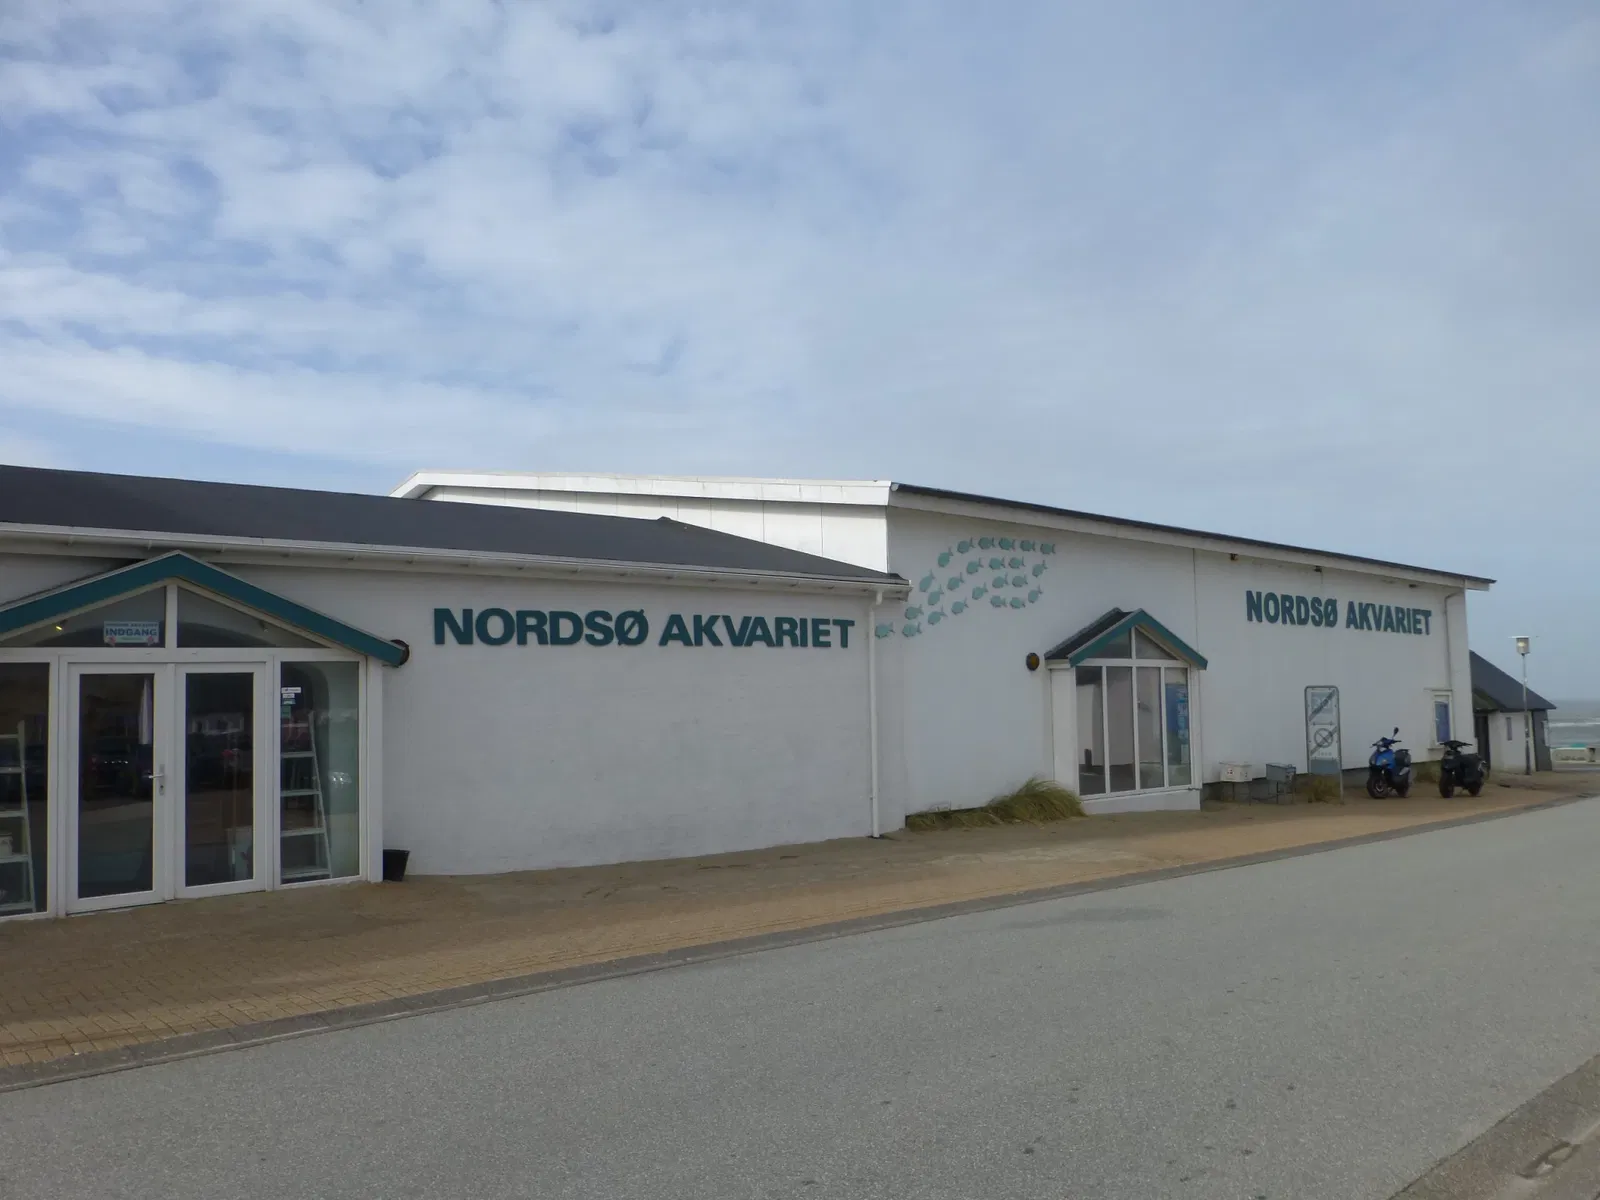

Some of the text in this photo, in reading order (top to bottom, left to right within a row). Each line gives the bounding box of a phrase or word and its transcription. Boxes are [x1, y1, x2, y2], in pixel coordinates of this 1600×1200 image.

[105, 628, 158, 636] INDGANG
[434, 608, 855, 649] NORDSØ AKVARIET
[1246, 590, 1432, 635] NORDSØ AKVARIET
